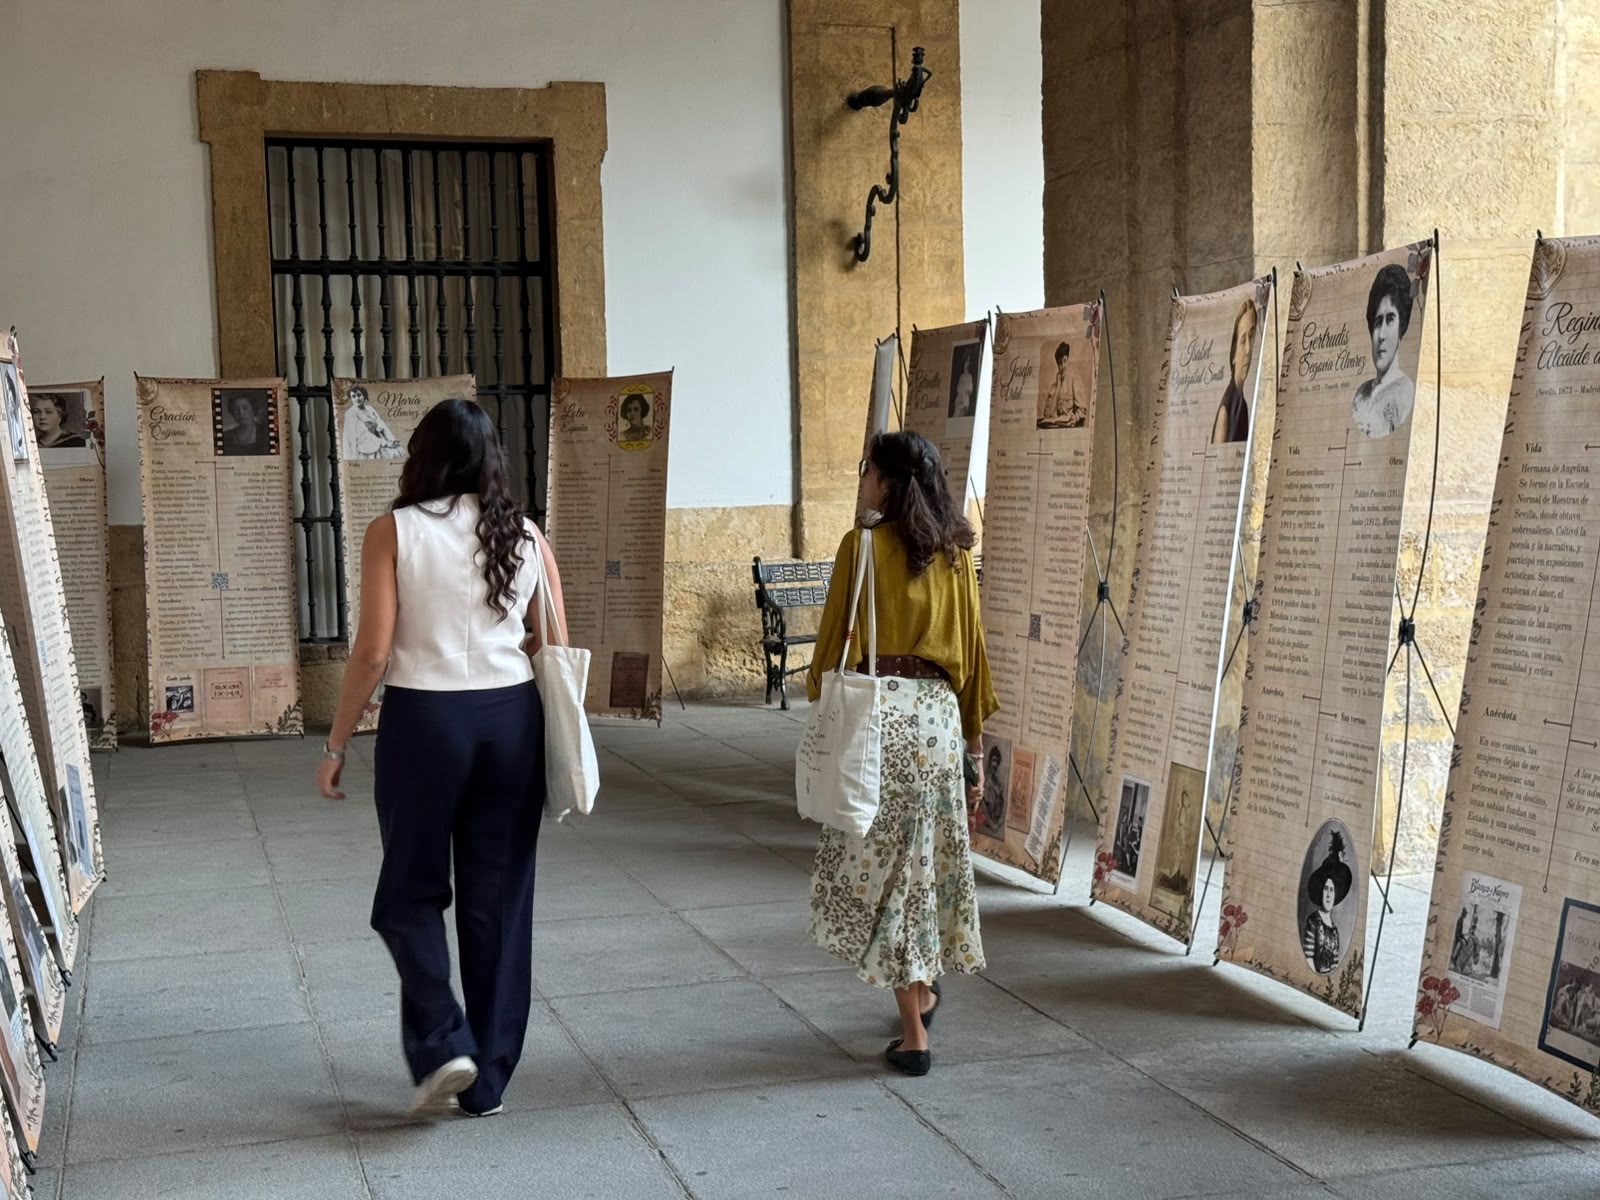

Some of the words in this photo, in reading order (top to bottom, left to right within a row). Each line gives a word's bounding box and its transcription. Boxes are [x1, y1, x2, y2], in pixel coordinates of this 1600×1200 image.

[1302, 322, 1350, 354] Gertrudis
[1537, 340, 1590, 370] Alcaide
[377, 391, 421, 407] María
[150, 406, 197, 424] Gracián
[1526, 443, 1542, 453] Vida
[1522, 464, 1550, 473] Hermana
[1552, 464, 1559, 473] de
[1561, 464, 1590, 474] Angelina.
[1519, 479, 1527, 489] Se
[1529, 479, 1547, 489] formó
[1549, 481, 1556, 489] en
[1558, 479, 1564, 489] la
[1566, 479, 1589, 489] Escuela
[1516, 494, 1541, 504] Normal
[1543, 495, 1550, 504] de
[1552, 495, 1579, 505] Maestras
[1581, 495, 1588, 505] de
[1514, 509, 1537, 520] Sevilla,
[1540, 511, 1558, 520] donde
[1580, 526, 1586, 536] la
[1531, 542, 1536, 551] y
[1537, 541, 1543, 551] la
[1536, 558, 1545, 566] en
[1483, 707, 1517, 721] Anécdota
